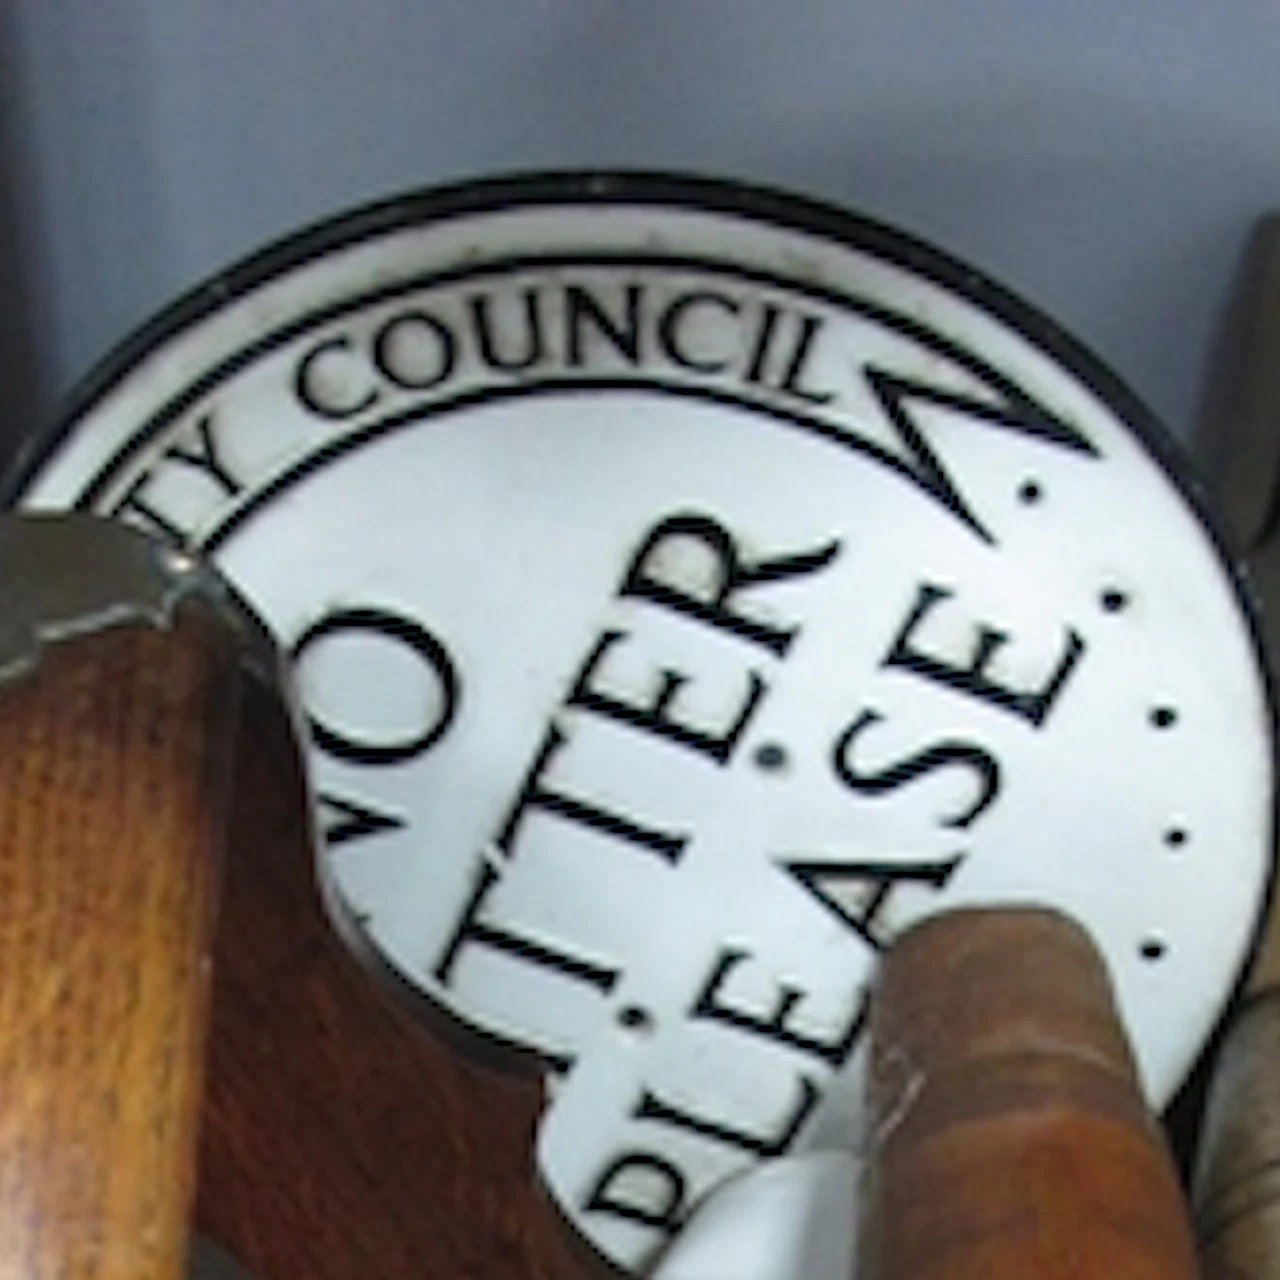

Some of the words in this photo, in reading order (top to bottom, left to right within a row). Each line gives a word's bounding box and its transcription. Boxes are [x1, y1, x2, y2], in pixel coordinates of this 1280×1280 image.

[292, 284, 838, 422] COUNCIL
[433, 508, 846, 1074] TTER
[580, 582, 1087, 1236] PLEASE
